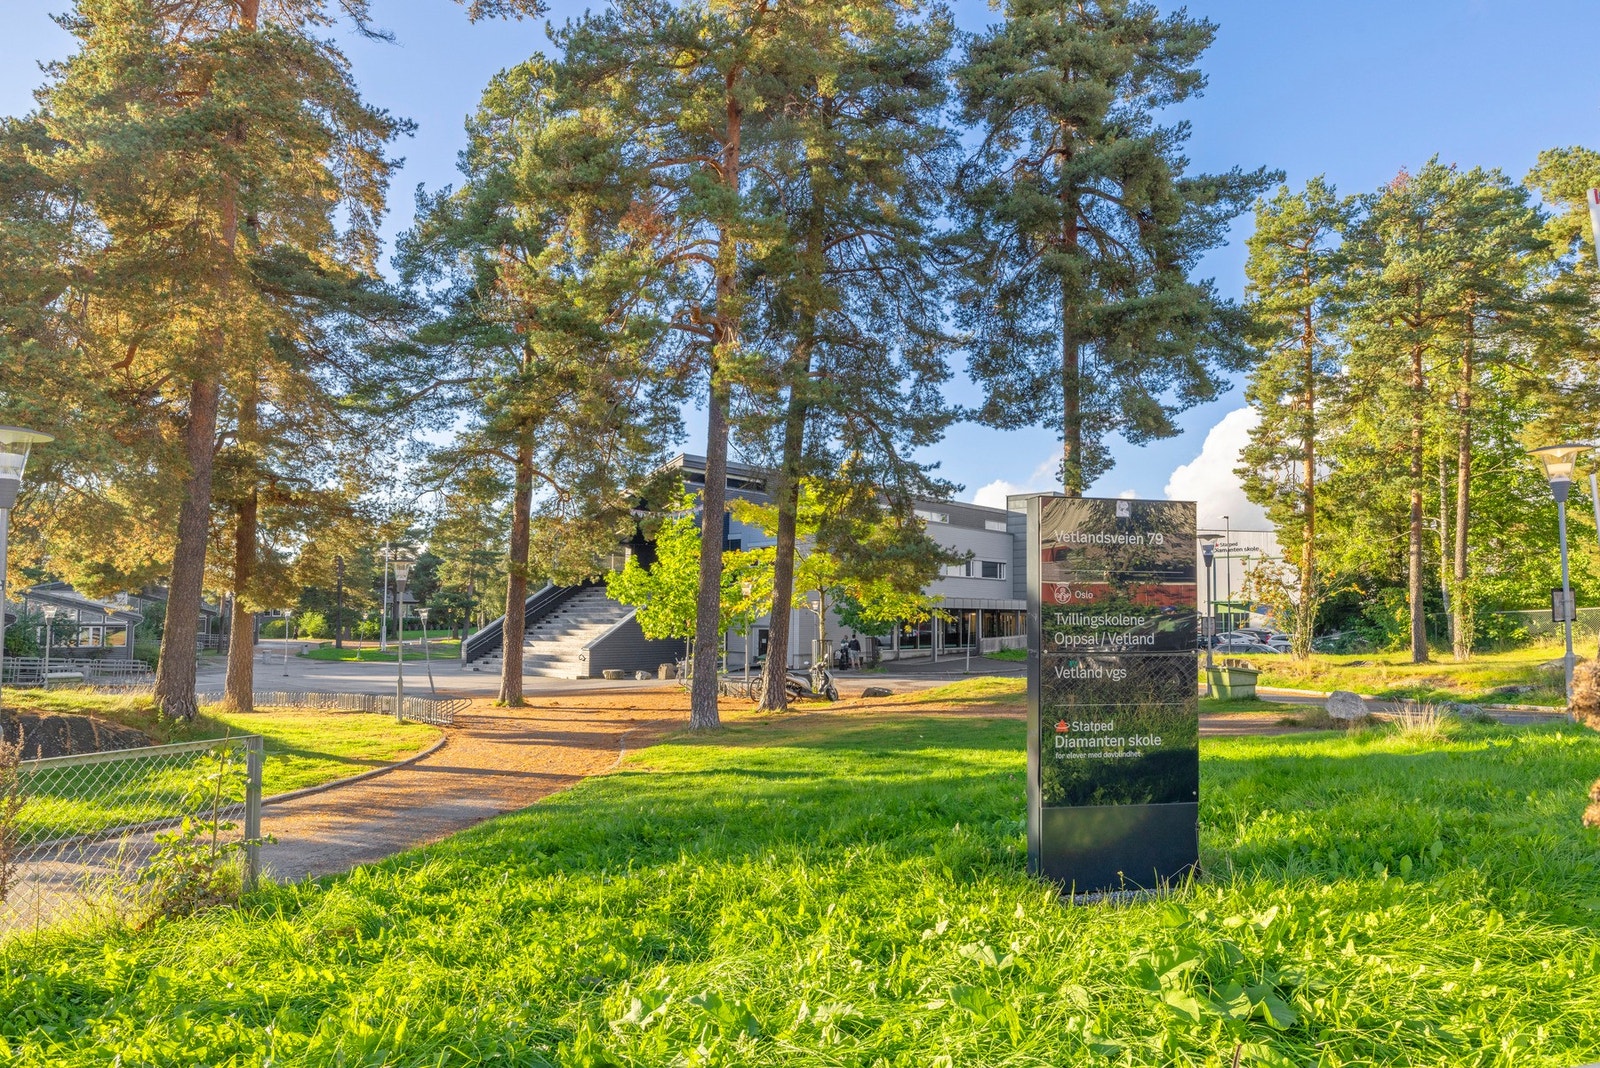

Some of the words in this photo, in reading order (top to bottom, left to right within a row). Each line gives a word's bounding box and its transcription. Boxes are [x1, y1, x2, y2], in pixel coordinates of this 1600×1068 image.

[1054, 531, 1144, 545] Vetlandsveien
[1147, 532, 1164, 545] 79
[1074, 590, 1094, 600] Oslo
[1054, 612, 1145, 629] Tvillingskolene
[1054, 632, 1099, 647] Oppsal
[1108, 632, 1155, 646] Vetland
[1054, 666, 1103, 679] Vetland
[1106, 668, 1127, 682] vgs
[1072, 720, 1114, 734] Statped
[1055, 734, 1125, 749] Diamanten
[1128, 733, 1162, 747] skole
